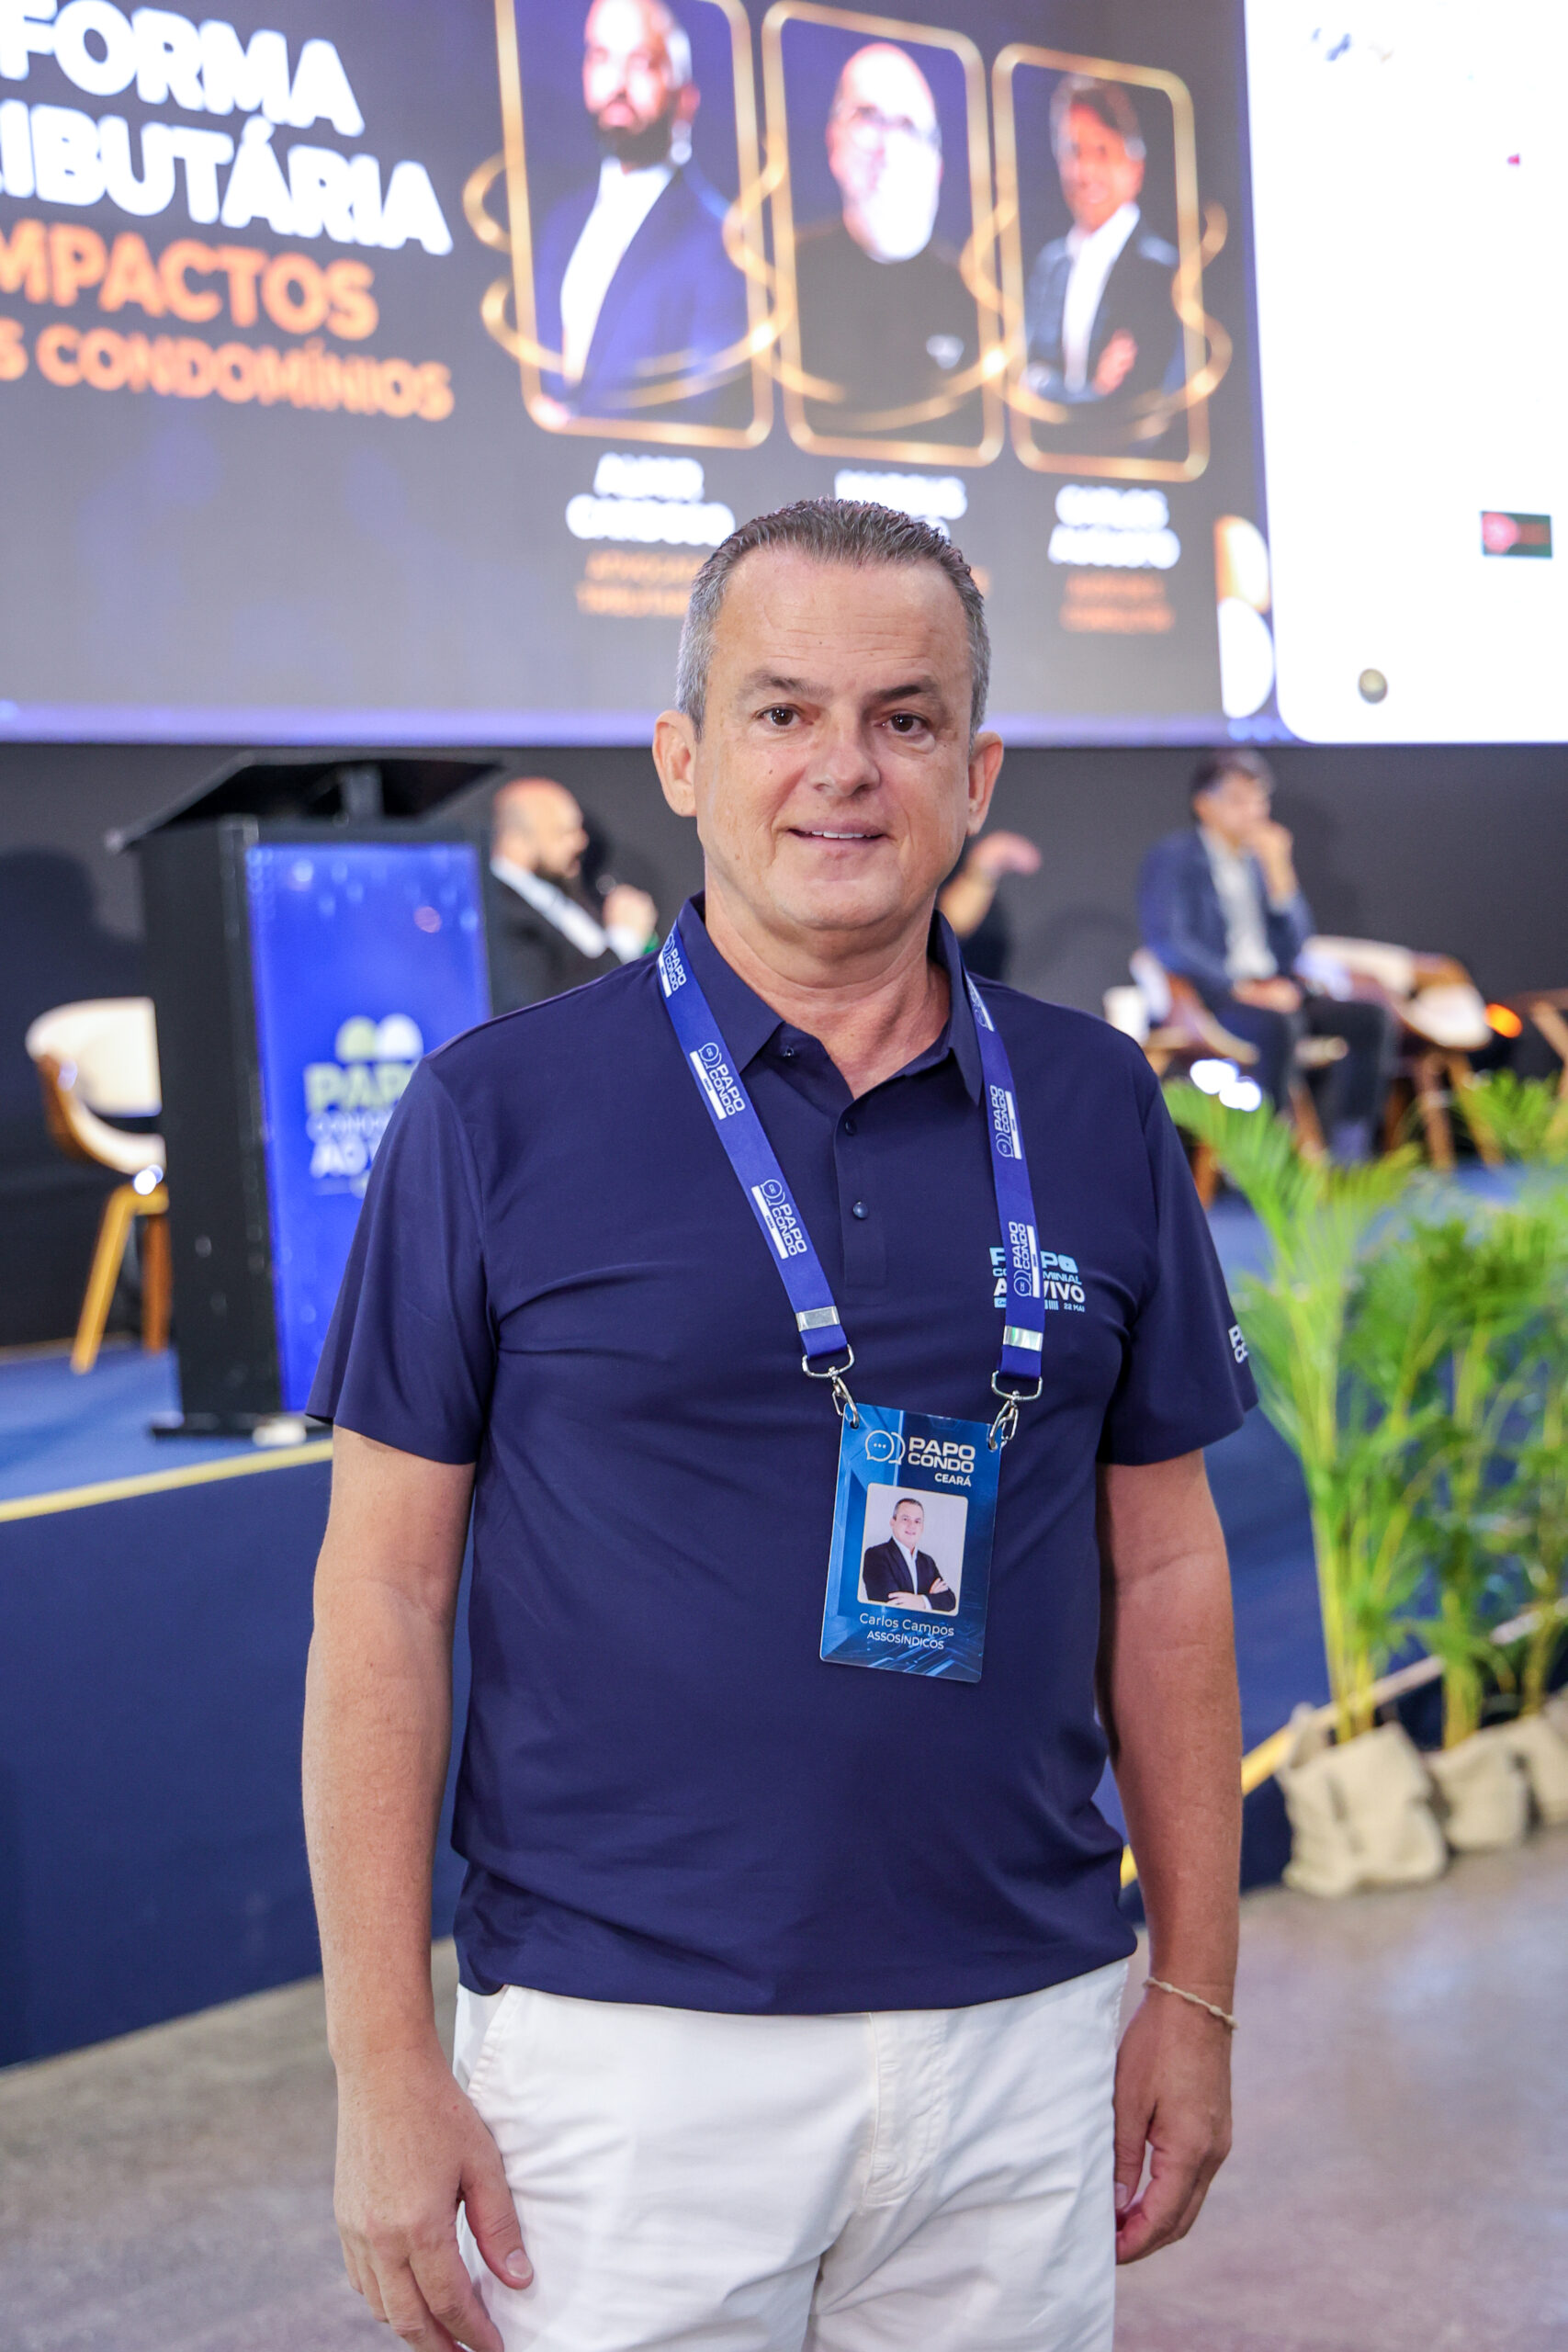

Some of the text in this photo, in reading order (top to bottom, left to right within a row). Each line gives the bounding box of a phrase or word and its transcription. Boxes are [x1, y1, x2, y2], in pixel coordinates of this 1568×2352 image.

[0, 99, 454, 255] IBUTÁRIA
[36, 323, 455, 422] CONDOMÍNIOS
[665, 956, 680, 991] CONDO
[671, 948, 687, 987] PAPO
[303, 1061, 419, 1114] PAP
[709, 1069, 736, 1115] CONDO
[716, 1063, 746, 1112] PAPO
[989, 1085, 1003, 1132] PAPO
[998, 1088, 1010, 1134] CONDO
[772, 1207, 797, 1256] CONDO
[779, 1204, 807, 1253] PAPO
[1009, 1221, 1022, 1269] PAPO
[1018, 1223, 1031, 1270] CONDO
[989, 1247, 1078, 1273] PPO
[908, 1436, 976, 1461] PAPO
[908, 1452, 975, 1474] CONDO
[934, 1473, 972, 1487] CEARÁ
[859, 1612, 954, 1636] Carlos Campos
[866, 1630, 944, 1650] ASSOSÍNDICOS
